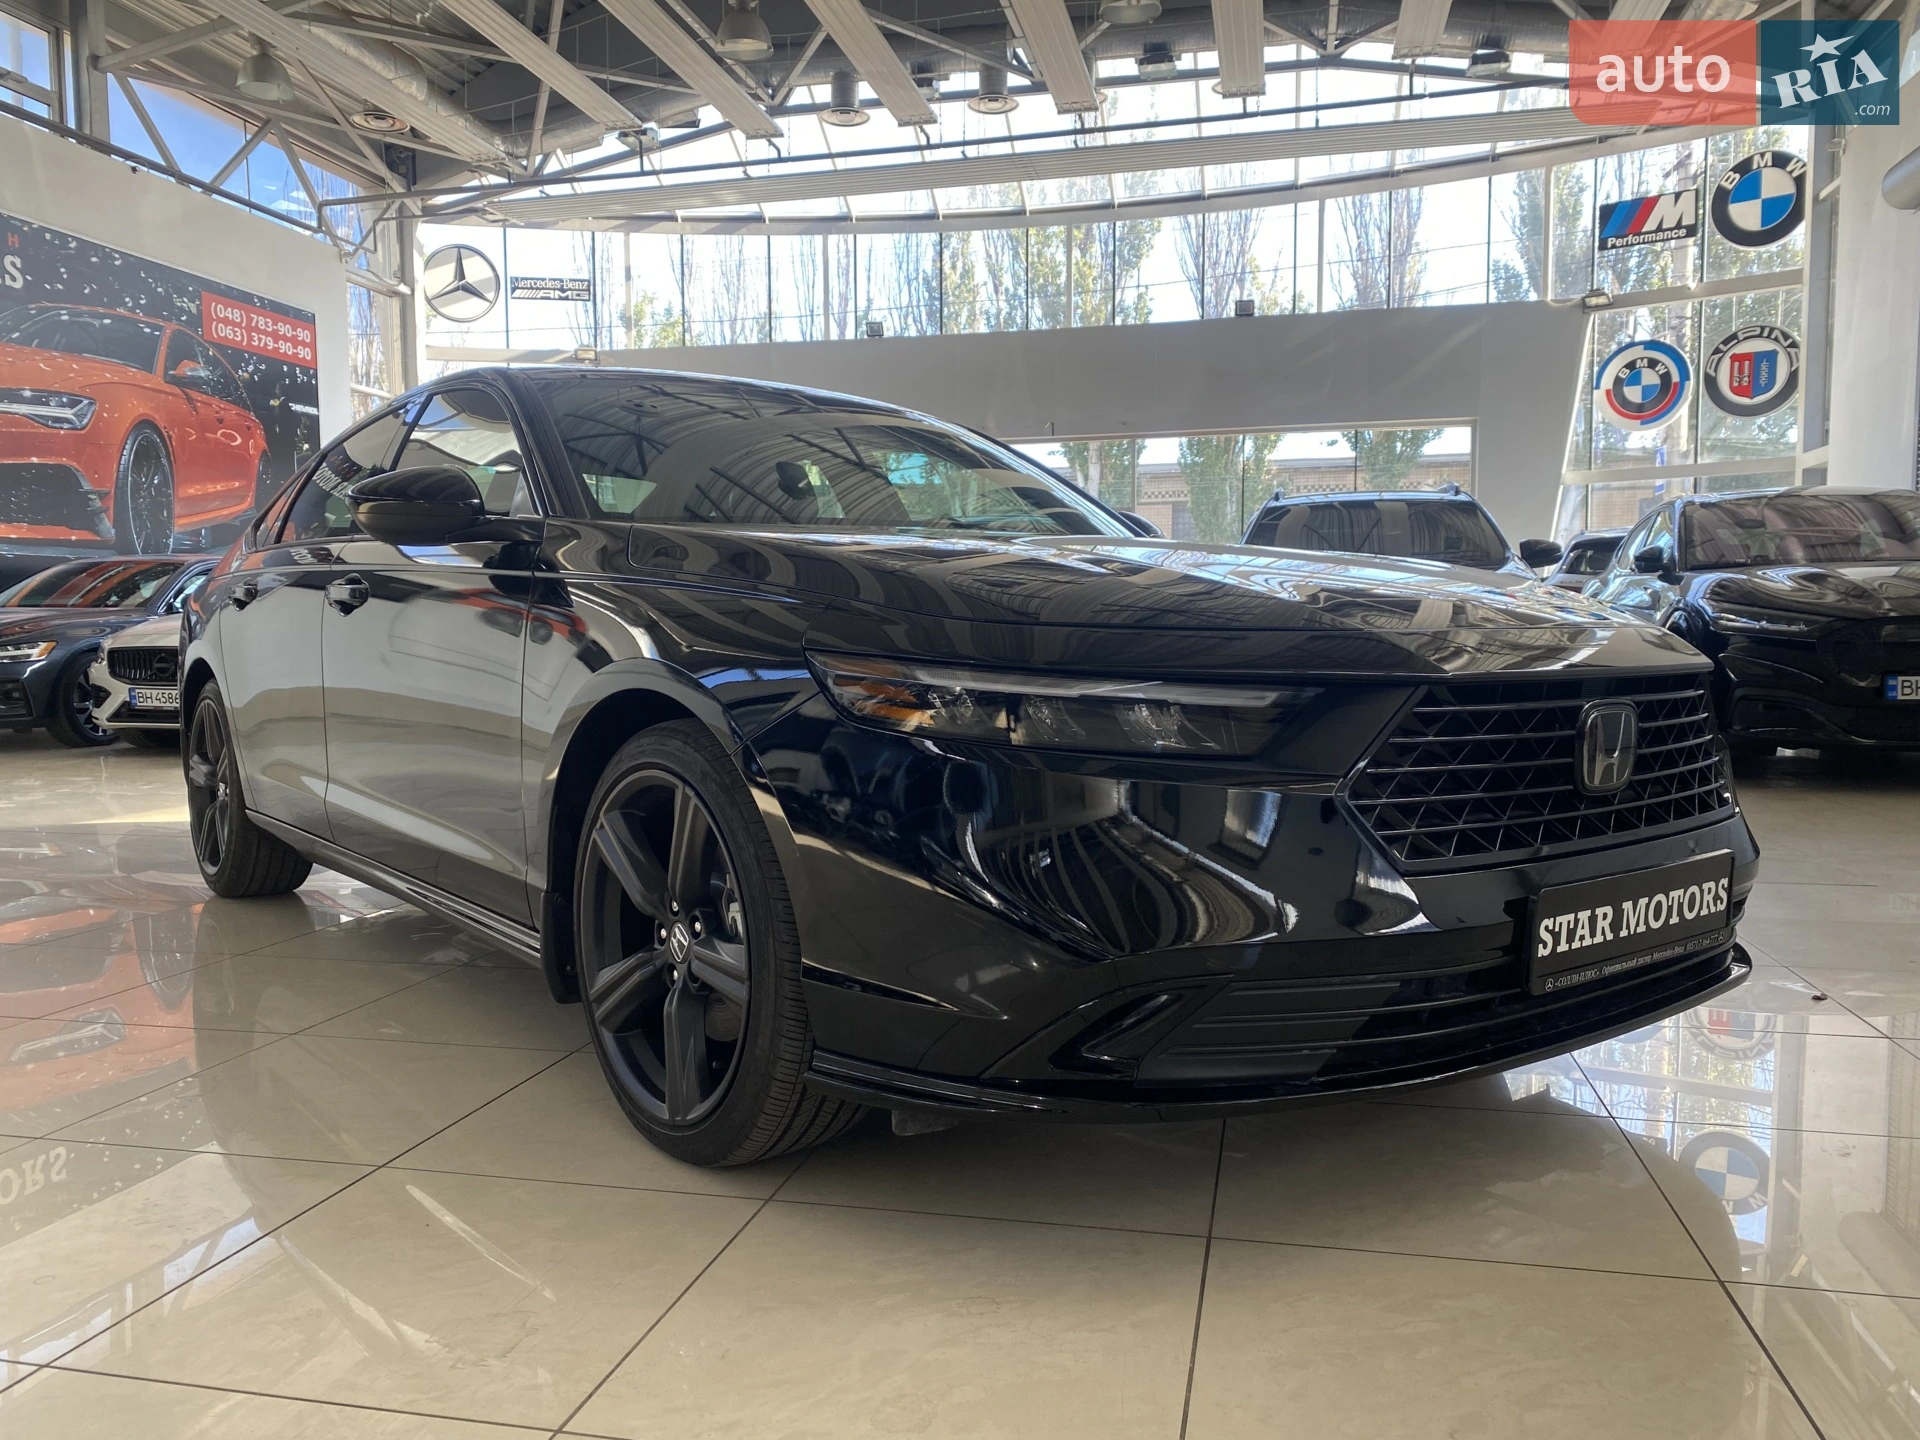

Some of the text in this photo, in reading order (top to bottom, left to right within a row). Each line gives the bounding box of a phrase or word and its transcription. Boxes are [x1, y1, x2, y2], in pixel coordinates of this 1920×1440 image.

[1719, 151, 1808, 190] BMW
[1641, 190, 1696, 233] M
[1607, 227, 1687, 249] Performance
[0, 254, 24, 290] S
[511, 276, 589, 290] Mercedes-Benz
[211, 302, 311, 343] (048) 783-90-90
[212, 321, 312, 360] (063) 379-90-90
[1618, 358, 1668, 379] BMW
[1706, 326, 1800, 378] ALPINA
[137, 691, 153, 704] BH
[1537, 877, 1729, 958] STAR MOTORS
